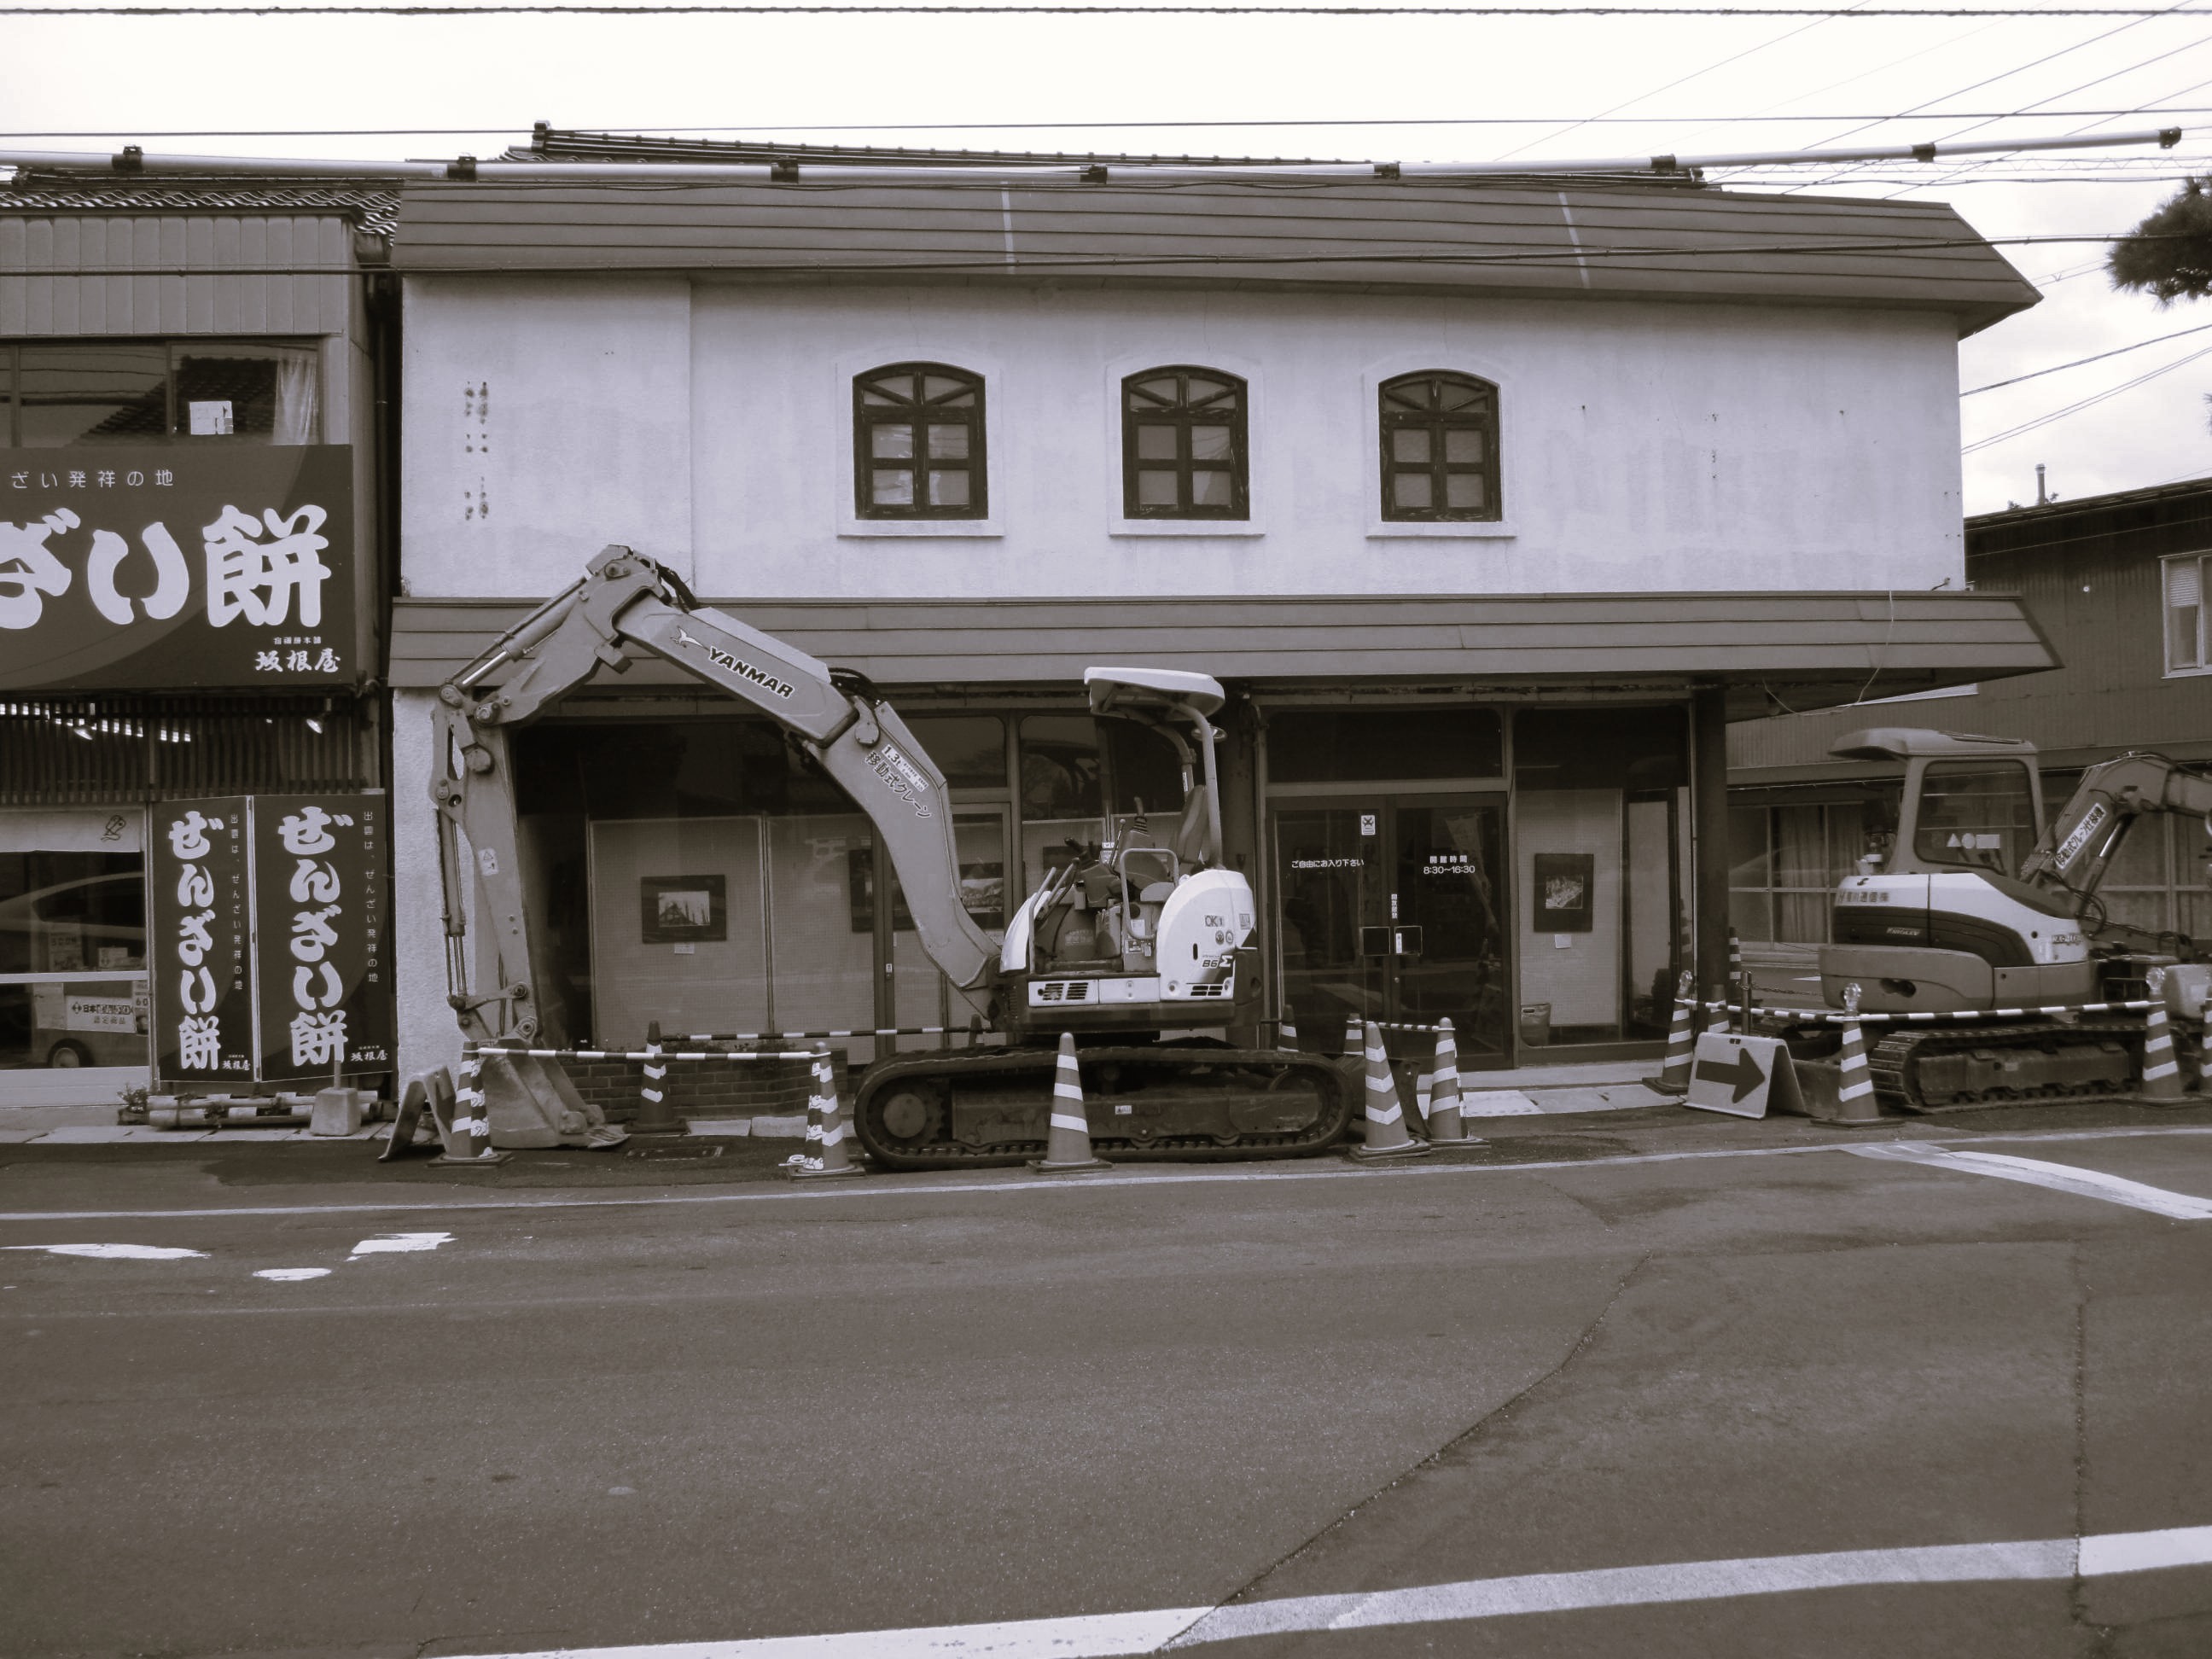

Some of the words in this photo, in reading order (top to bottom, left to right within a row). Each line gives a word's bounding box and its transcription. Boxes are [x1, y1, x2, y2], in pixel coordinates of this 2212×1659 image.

[11, 469, 173, 488] ざい発祥の地
[709, 646, 795, 699] YANMAR
[865, 751, 932, 818] 移動式クレーン
[1291, 859, 1365, 869] ご自由にお入り下さい
[169, 811, 224, 1070] ぜんざい餅
[277, 806, 354, 1067] ぜんざい餅
